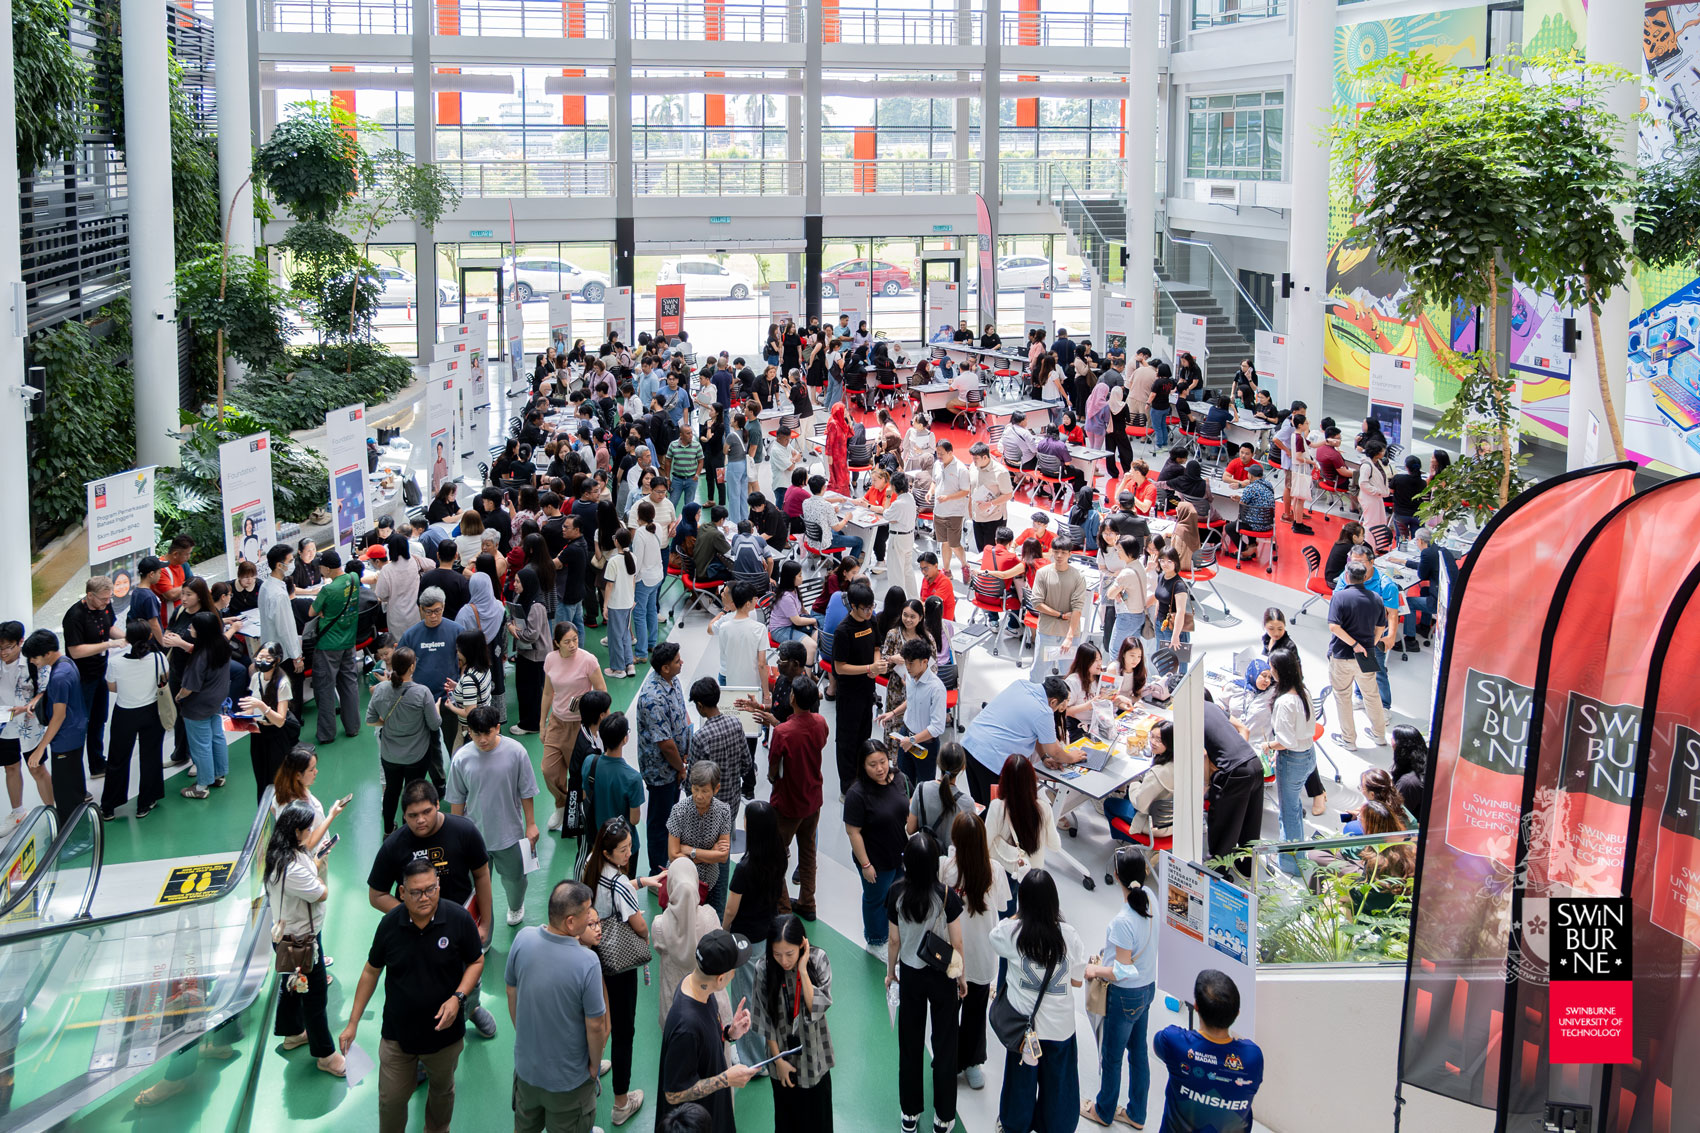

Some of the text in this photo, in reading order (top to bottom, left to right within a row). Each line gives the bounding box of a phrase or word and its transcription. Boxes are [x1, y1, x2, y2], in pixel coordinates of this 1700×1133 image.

[227, 466, 257, 480] Foundation
[96, 511, 118, 522] Program
[420, 641, 446, 649] Explore
[1482, 708, 1528, 743] BU
[1586, 737, 1634, 768] BU
[1462, 801, 1520, 826] UNIVERSIT
[1168, 863, 1182, 872] WORK
[1168, 868, 1199, 886] INTEGRATED
[1168, 873, 1193, 889] LEARNING
[1194, 1056, 1218, 1065] MADANI
[1179, 1085, 1249, 1111] FINISHER
